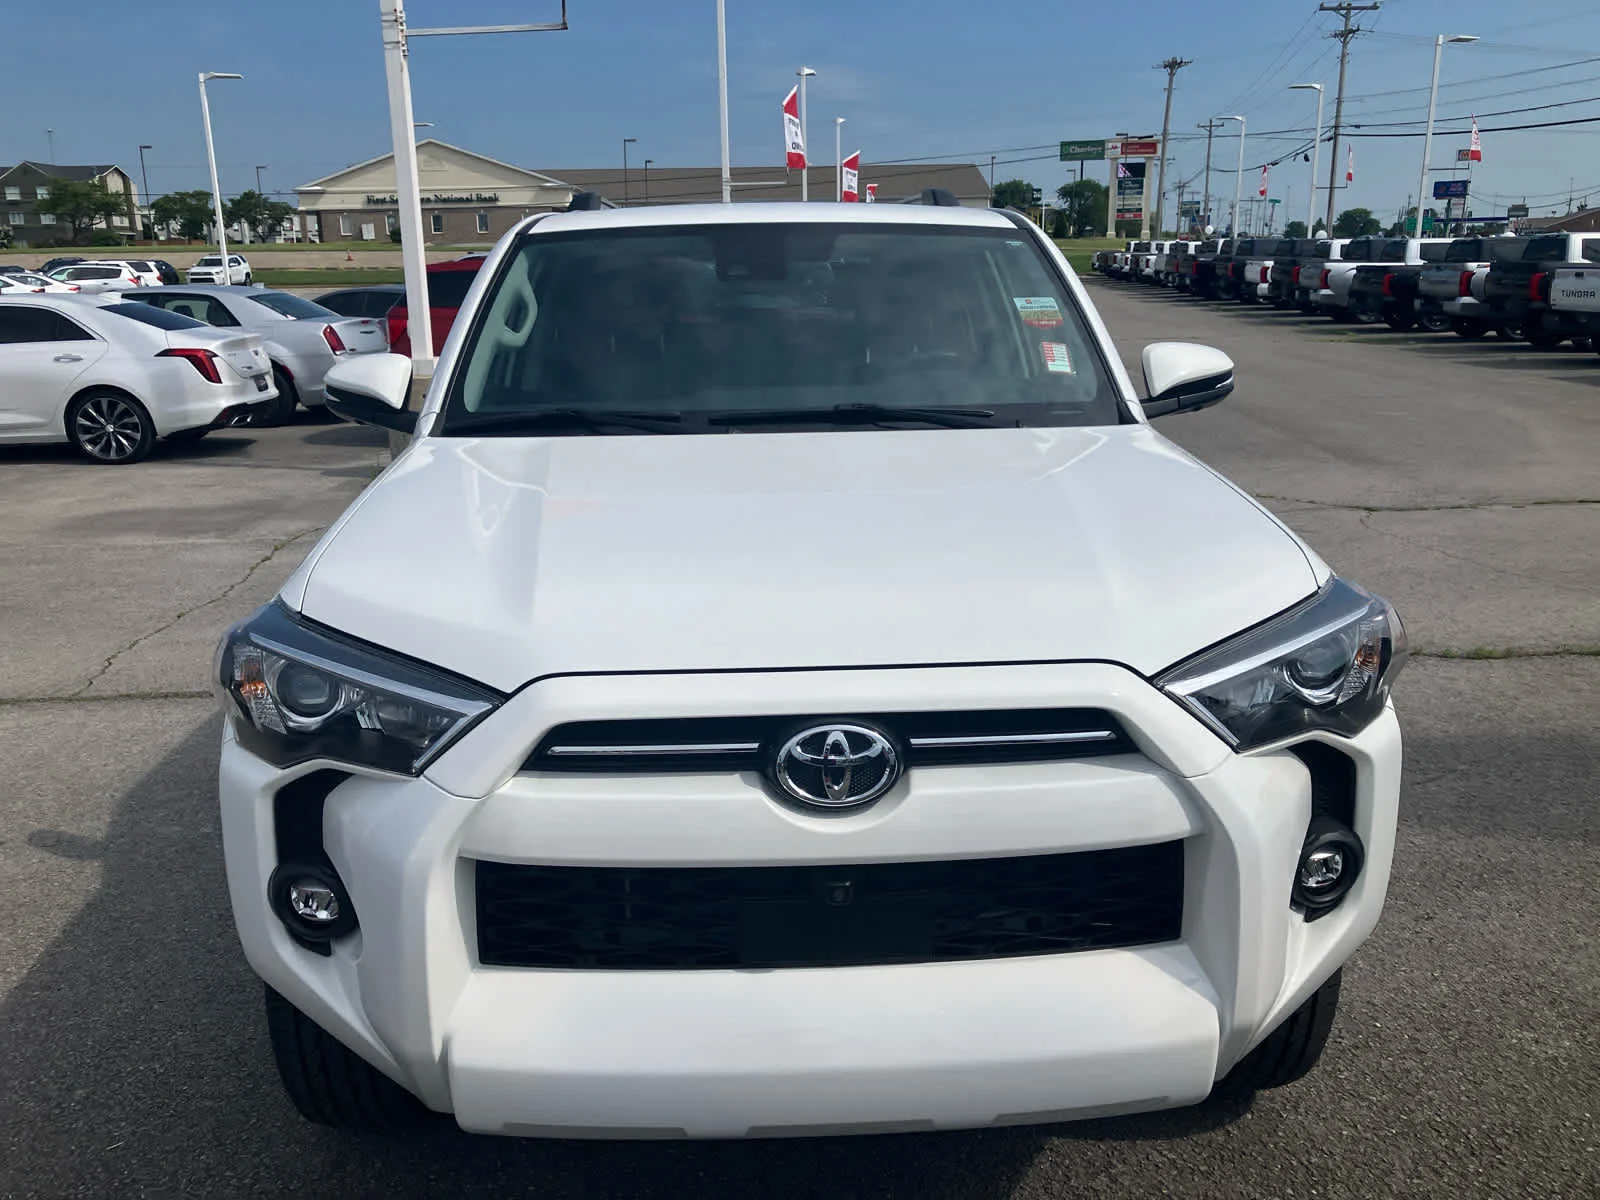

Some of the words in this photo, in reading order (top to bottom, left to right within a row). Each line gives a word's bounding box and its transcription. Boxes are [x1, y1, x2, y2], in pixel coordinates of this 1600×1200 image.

[434, 193, 473, 203] National
[476, 193, 500, 203] Bank
[1561, 290, 1596, 298] TUNDRA
